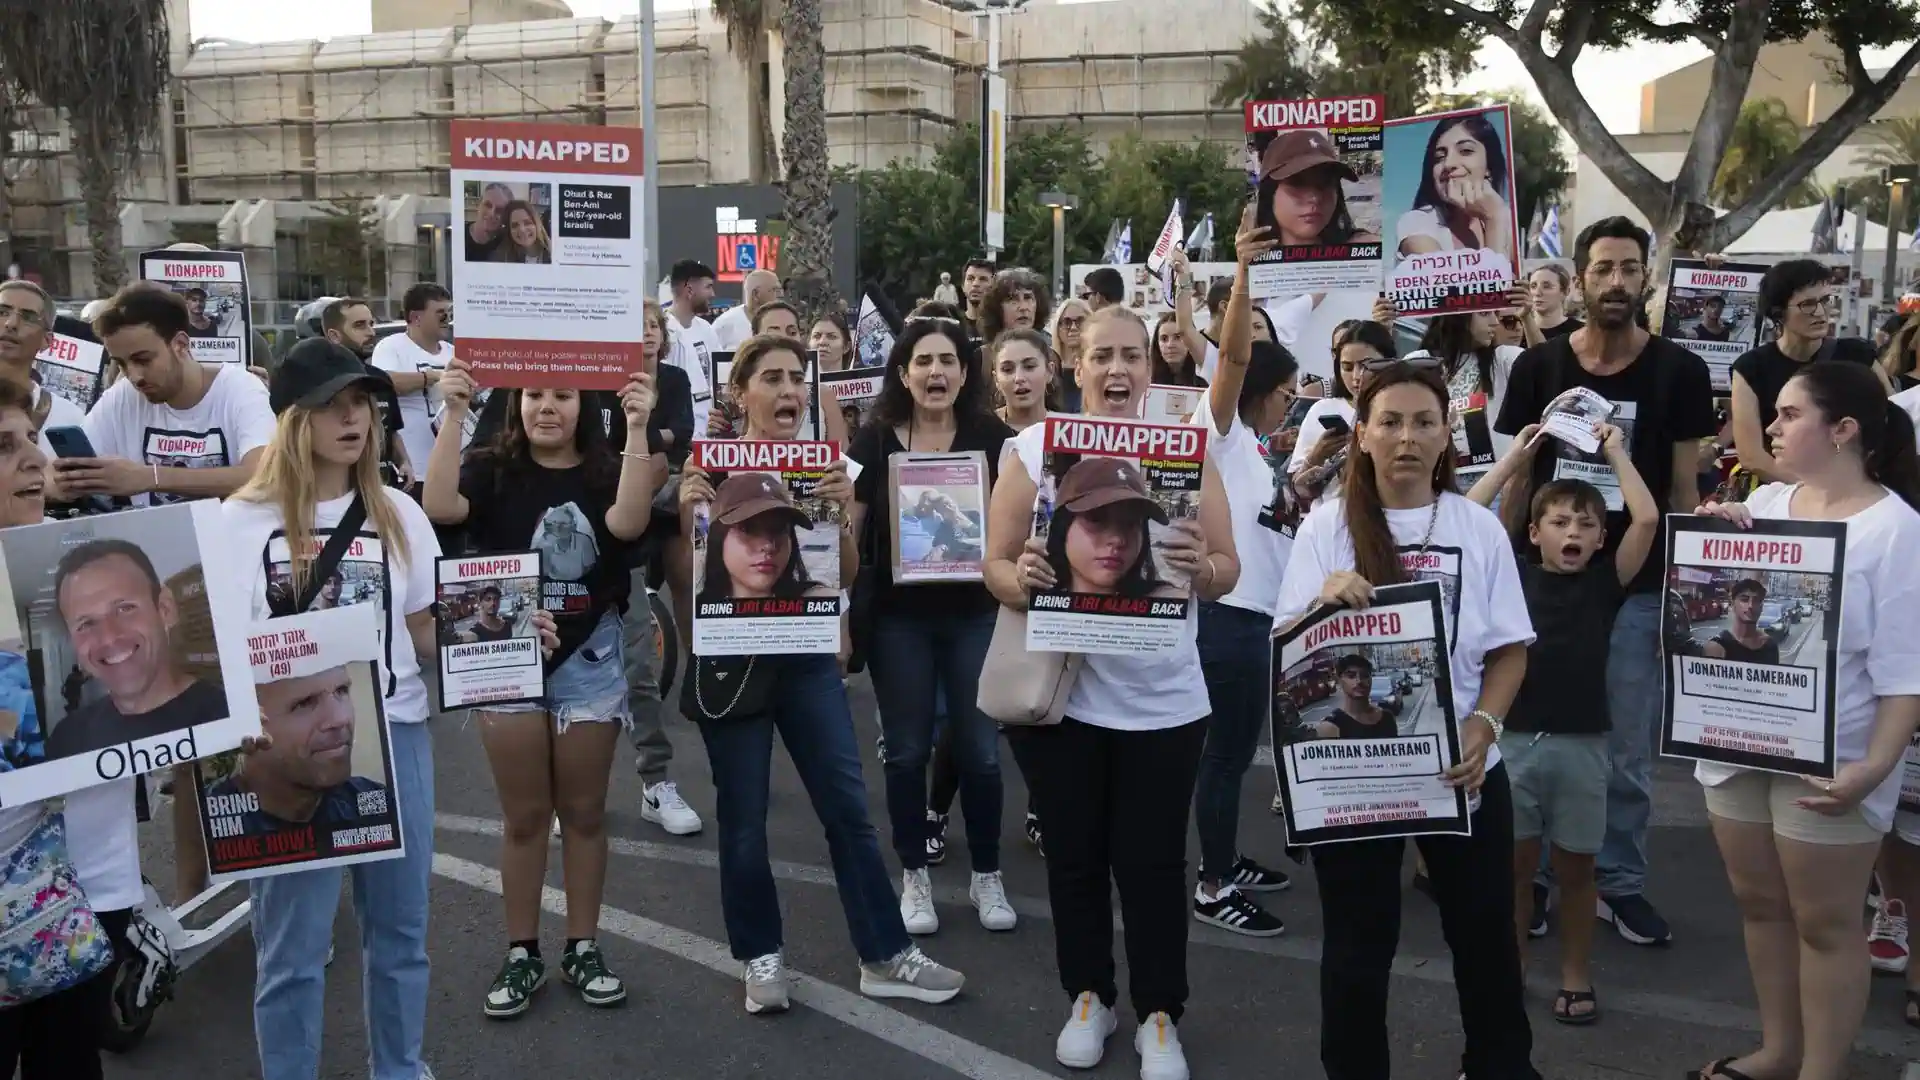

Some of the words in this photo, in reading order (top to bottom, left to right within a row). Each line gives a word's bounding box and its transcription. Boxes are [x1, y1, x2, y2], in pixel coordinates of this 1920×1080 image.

[1253, 99, 1376, 127] KIDNAPPED
[465, 137, 630, 164] KIDNAPPED
[597, 191, 613, 199] Raz
[564, 201, 600, 209] Ben-Ami
[1351, 246, 1378, 257] BACK
[1412, 256, 1452, 270] זכריה
[1457, 253, 1481, 269] עדן
[164, 263, 225, 279] KIDNAPPED
[1395, 276, 1429, 289] EDEN
[1434, 269, 1502, 285] ZECHARIA
[1691, 272, 1748, 287] KIDNAPPED
[1386, 286, 1449, 300] BRING
[1456, 281, 1510, 296] THEM
[1395, 298, 1440, 311] OME
[197, 340, 236, 350] SAMERANO
[472, 360, 501, 369] Please
[503, 361, 523, 371] help
[525, 361, 548, 372] bring
[550, 363, 573, 371] them
[575, 364, 600, 372] home
[1052, 421, 1198, 456] KIDNAPPED
[701, 443, 831, 468] KIDNAPPED
[1702, 538, 1802, 565] KIDNAPPED
[459, 559, 521, 578] KIDNAPPED
[543, 582, 566, 595] RING
[701, 603, 733, 615] BRING
[807, 601, 836, 613] BACK
[1034, 595, 1071, 609] BRING
[1151, 602, 1184, 616] BACK
[282, 629, 306, 645] אוהד
[1304, 612, 1402, 652] KIDNAPPED
[247, 634, 279, 651] יהלומי
[452, 646, 490, 658] JONATHAN
[491, 641, 531, 654] SAMERANO
[268, 642, 319, 662] YAHALOMI
[270, 662, 291, 678] (49)
[1688, 662, 1743, 680] JONATHAN
[1746, 667, 1808, 688] SAMERANO
[96, 727, 198, 781] Ohad
[1301, 744, 1362, 760] JONATHAN
[1365, 741, 1431, 757] SAMERANO
[206, 792, 260, 817] BRING
[210, 816, 244, 838] HIM
[215, 836, 262, 861] HOME
[266, 826, 315, 854] NOW!
[334, 834, 366, 848] FAMILIES
